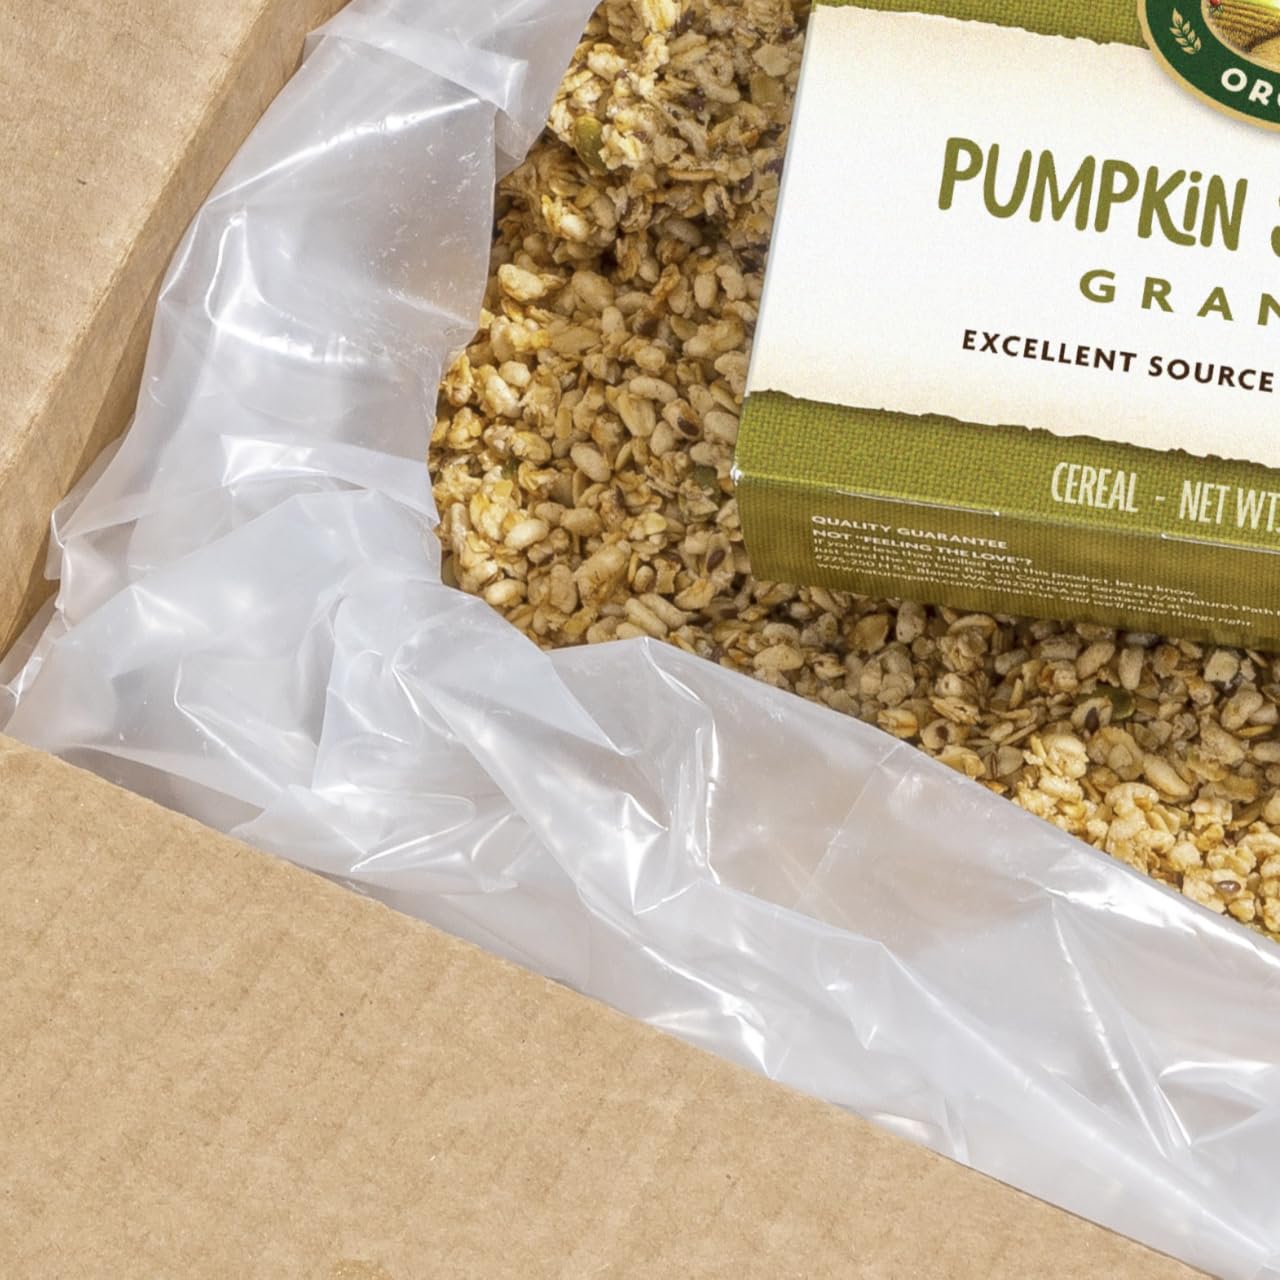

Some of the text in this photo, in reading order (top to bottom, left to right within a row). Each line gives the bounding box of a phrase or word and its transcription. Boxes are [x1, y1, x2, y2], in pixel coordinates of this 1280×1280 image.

[962, 328, 1137, 373] EXCELLENT
[1148, 356, 1275, 393] SOURCE
[1051, 462, 1139, 513] CEREAL
[1179, 479, 1231, 525] NET
[811, 515, 1009, 549] QUALITY GUARANTEE
[812, 528, 852, 541] NOT
[936, 546, 969, 558] THE
